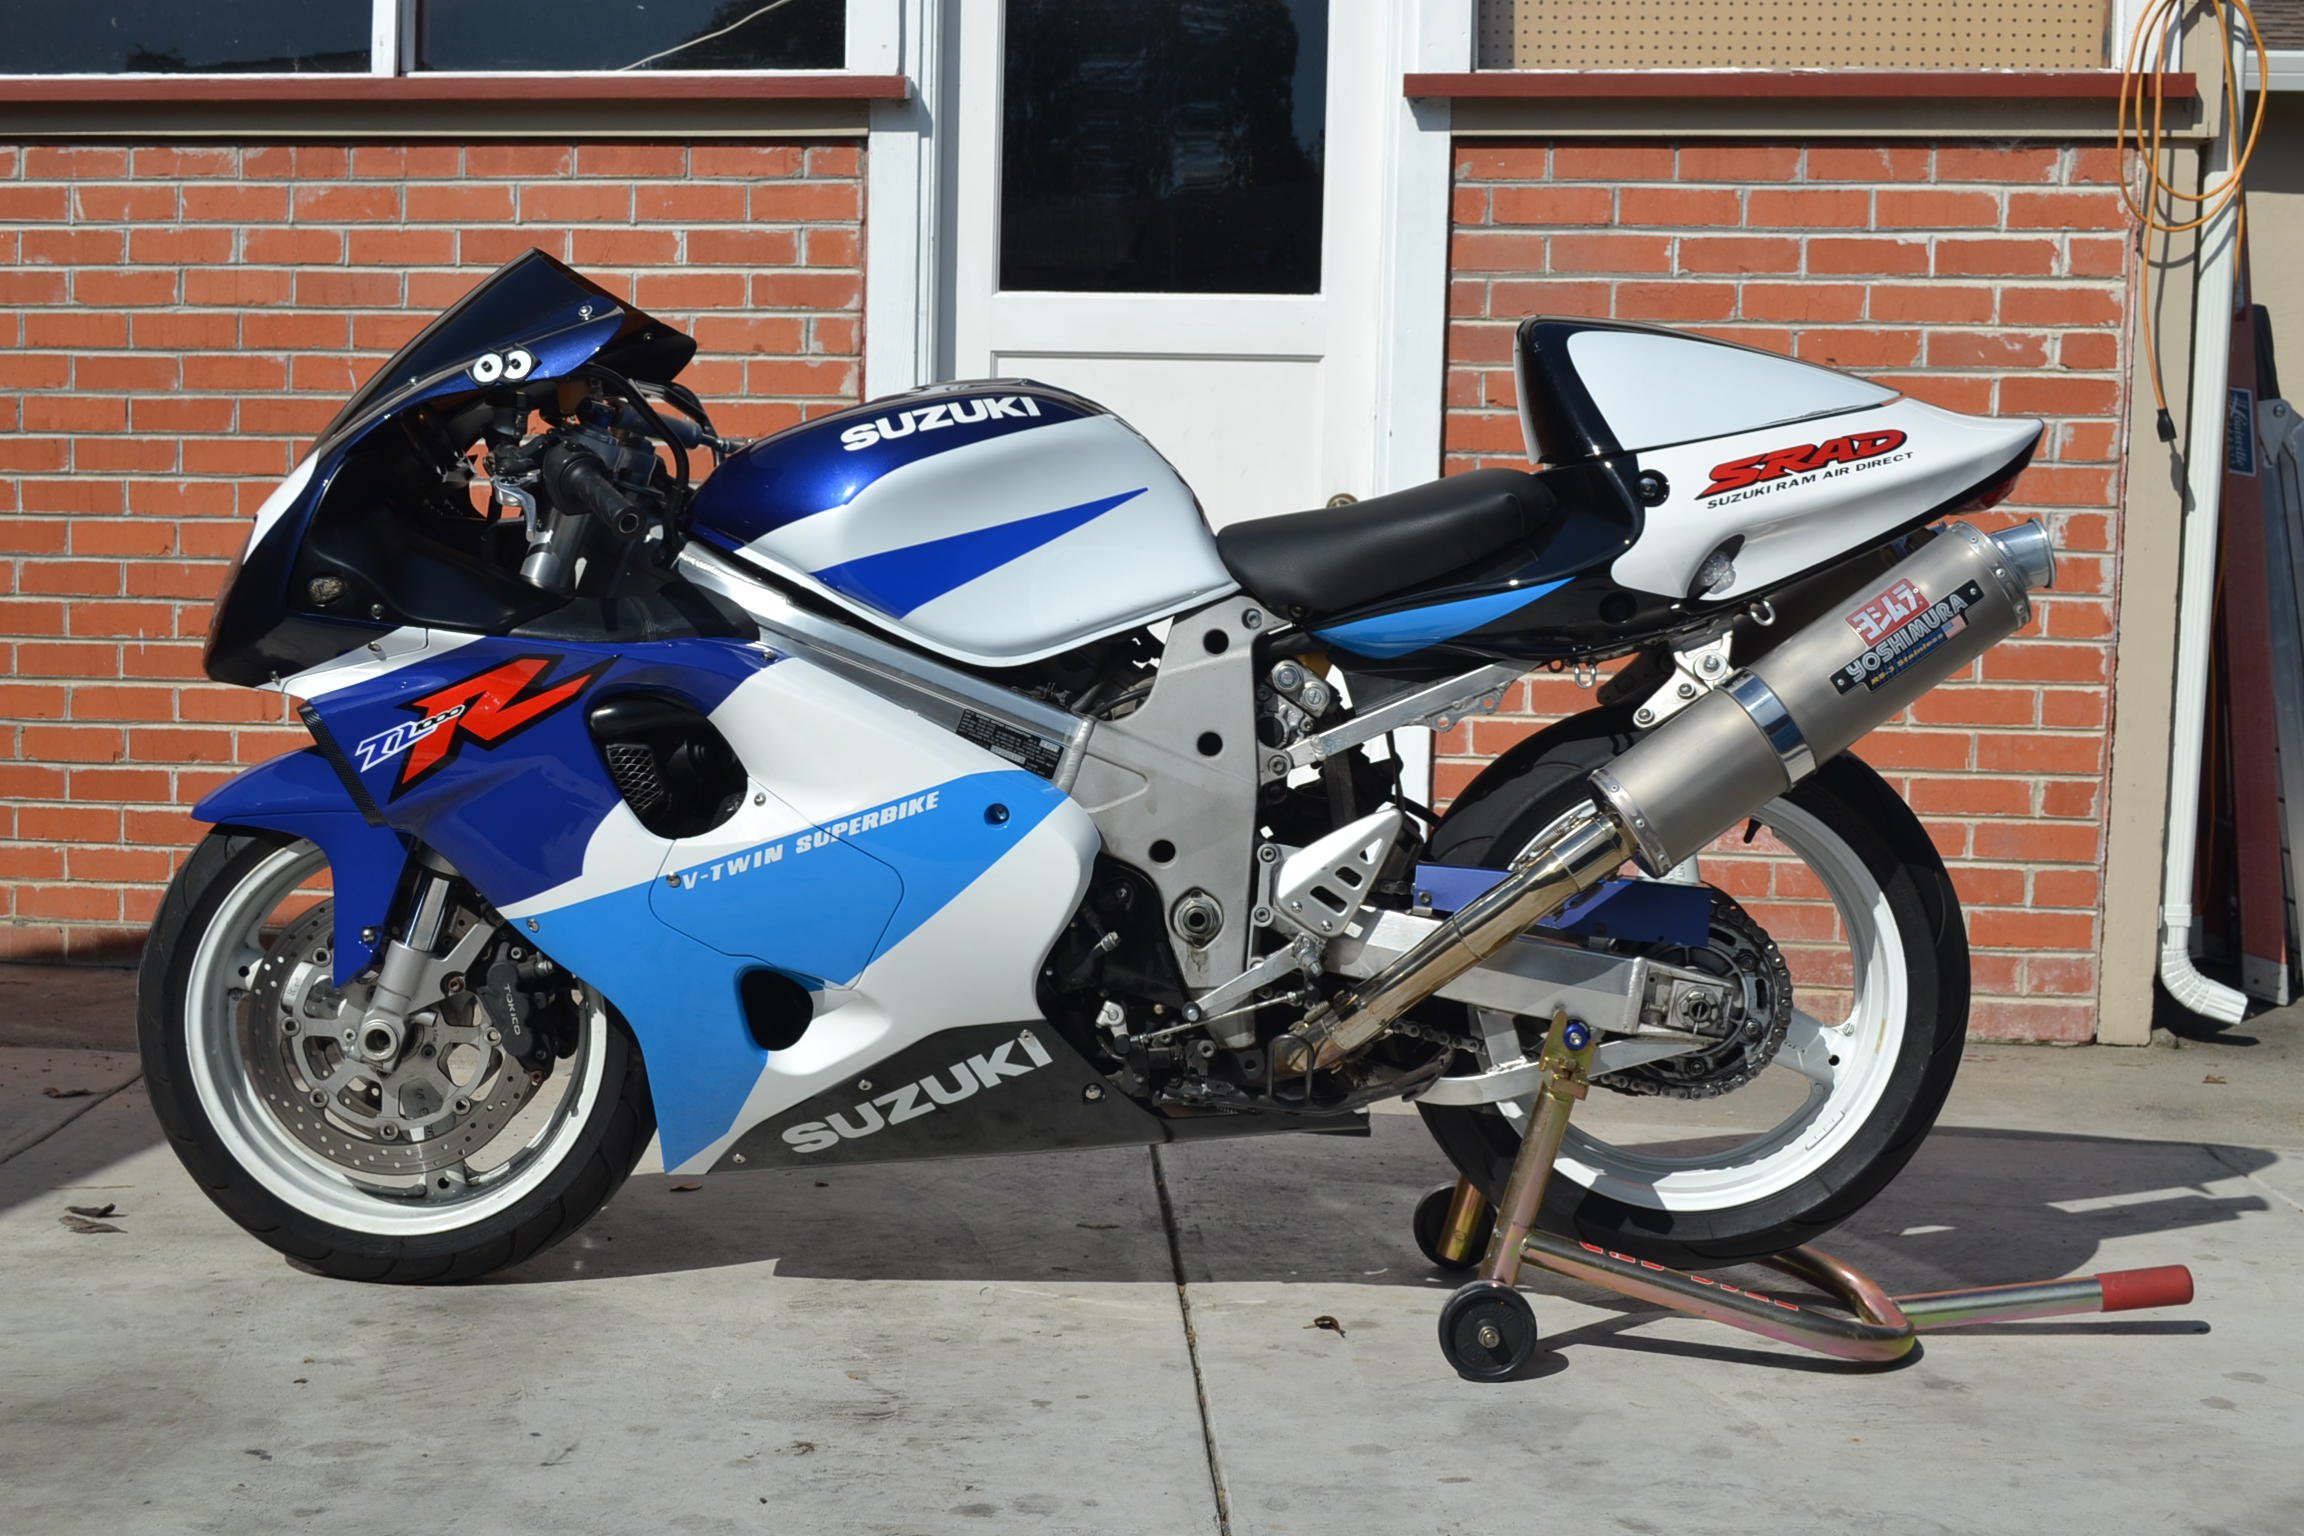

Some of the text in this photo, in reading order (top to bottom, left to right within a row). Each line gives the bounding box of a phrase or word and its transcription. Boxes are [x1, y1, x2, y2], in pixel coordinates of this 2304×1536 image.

[840, 396, 1041, 452] SUZUKI
[1695, 429, 1907, 500] SRAD
[1707, 451, 1914, 509] SUZUKI RAM AIR DIRECT
[1845, 594, 1968, 683] YOSHIMURA
[682, 790, 940, 890] V-TWIN SUPERBIKE
[504, 983, 521, 1036] TOKICO
[781, 1035, 1053, 1153] SUZUKI
